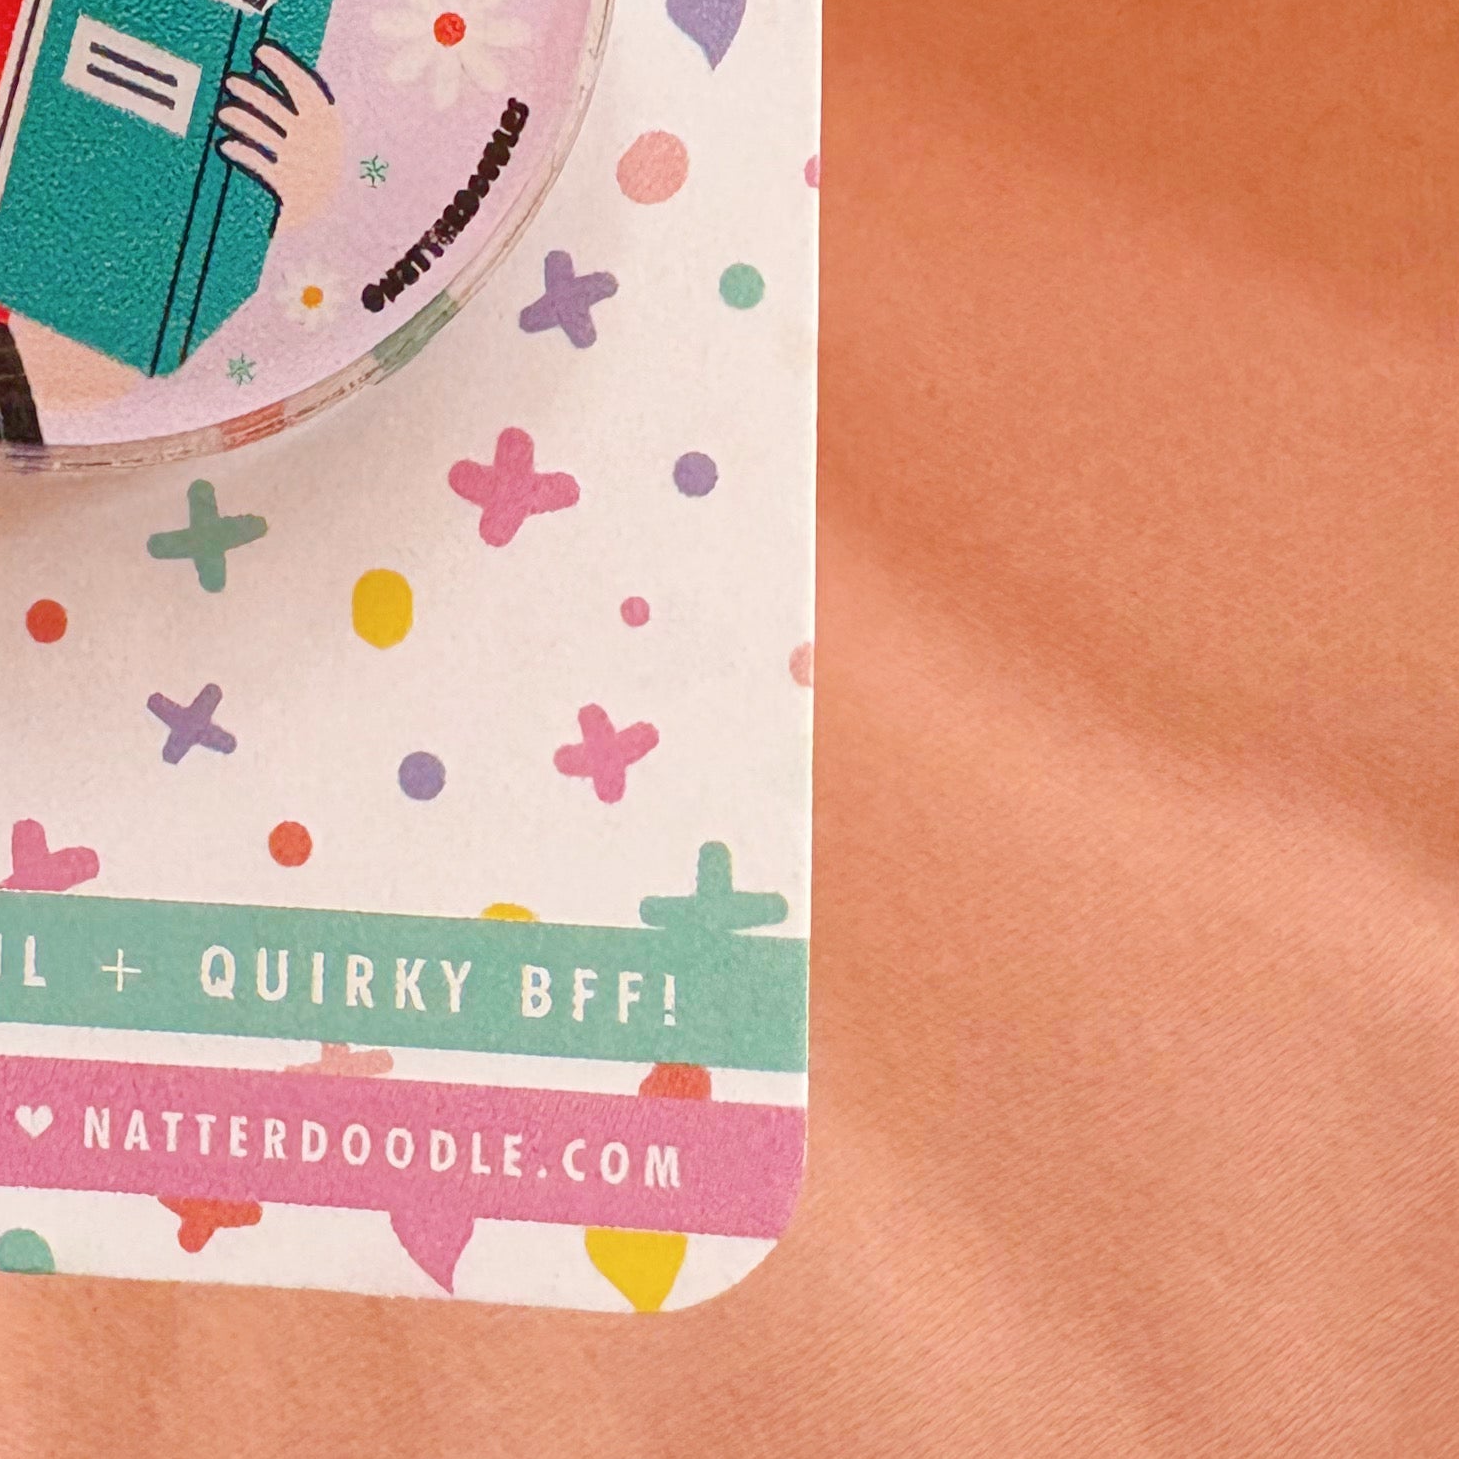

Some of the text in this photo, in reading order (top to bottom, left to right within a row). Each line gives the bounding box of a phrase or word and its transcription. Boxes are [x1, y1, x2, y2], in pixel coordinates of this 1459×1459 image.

[102, 948, 142, 991] +
[200, 945, 472, 1013] QUIRKY
[520, 964, 676, 1026] BFF!
[83, 1106, 680, 1188] NATTERDOODLE.COM
